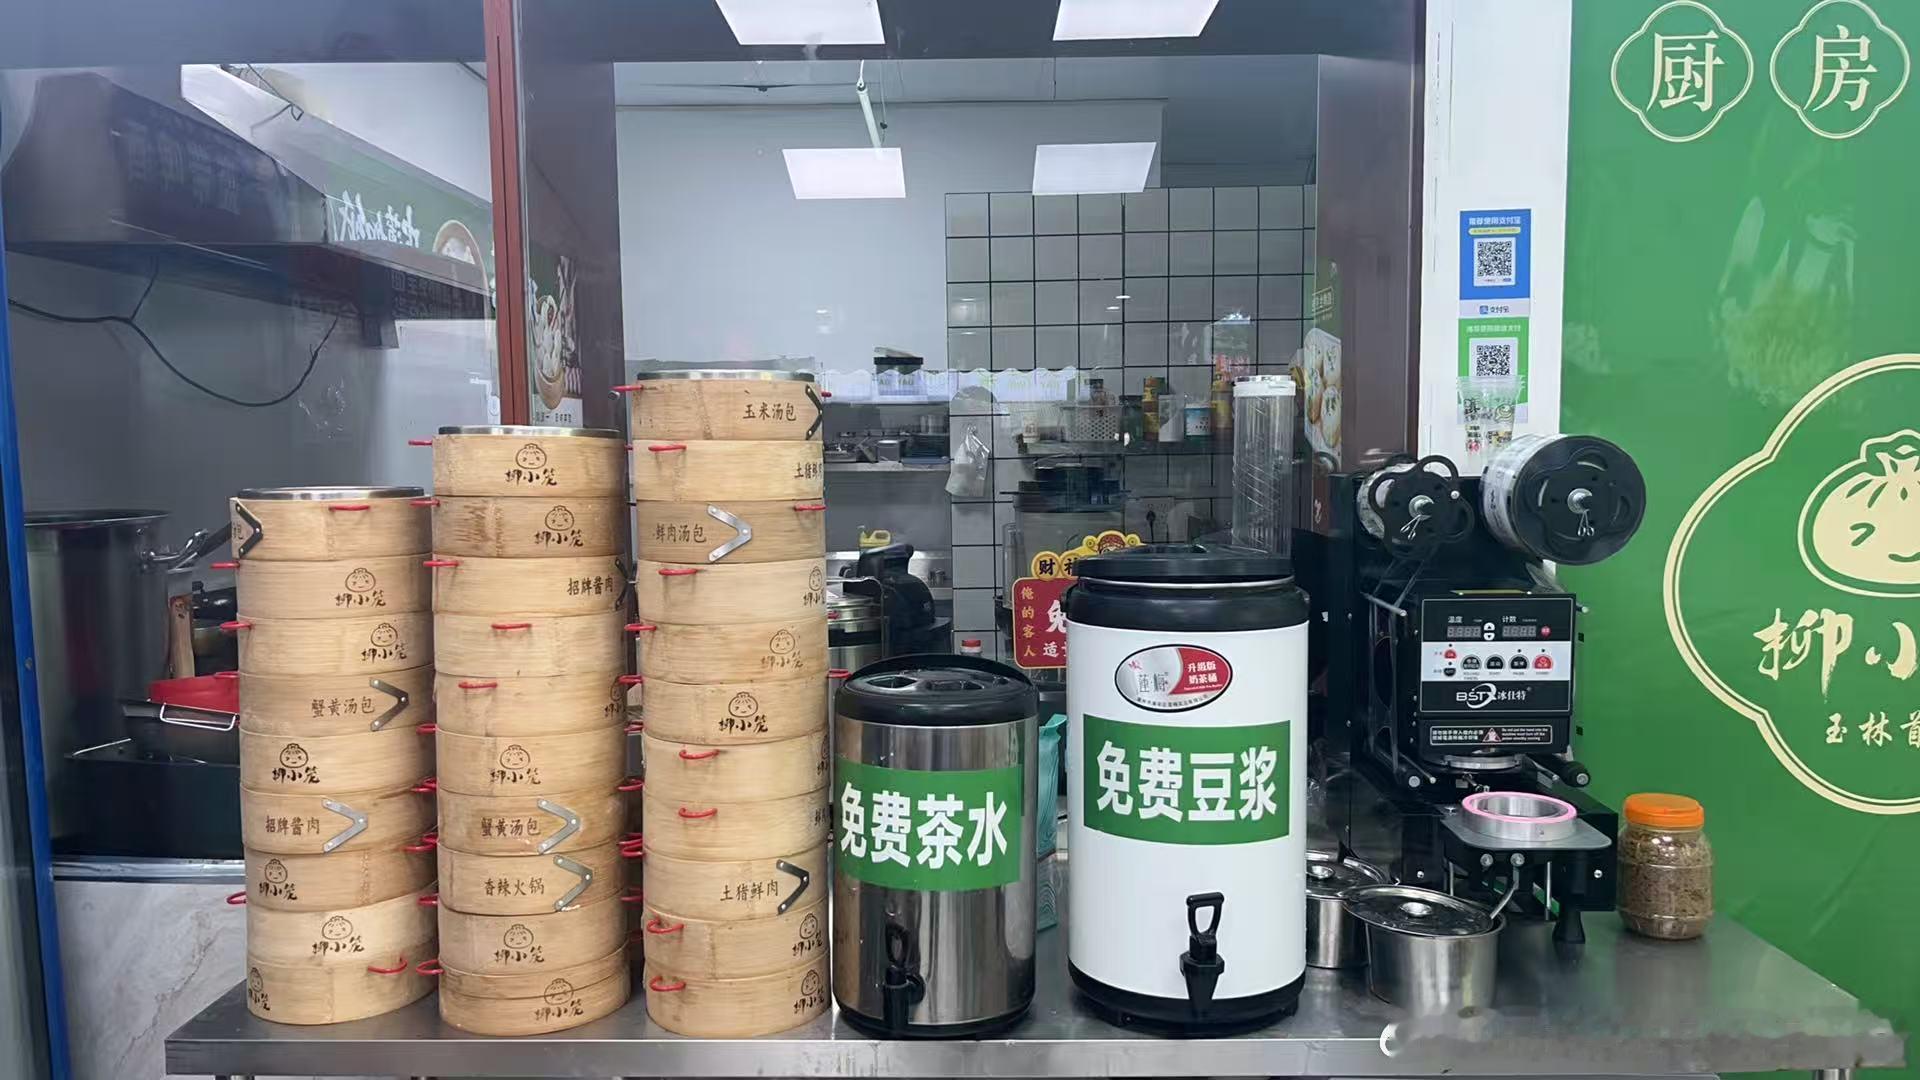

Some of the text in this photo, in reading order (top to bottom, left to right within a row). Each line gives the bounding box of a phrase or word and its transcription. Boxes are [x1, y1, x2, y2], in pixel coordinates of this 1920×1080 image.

[1646, 25, 1878, 111] 厨房
[742, 402, 797, 422] 玉米汤包
[654, 524, 707, 543] 鲜肉汤包
[568, 574, 614, 595] 招牌酱肉
[1021, 586, 1036, 657] 俺的客人
[1043, 641, 1067, 658] 适
[1188, 661, 1217, 673] 升级版
[311, 696, 376, 718] 蟹黄汤包
[1097, 740, 1277, 823] 免费豆浆
[265, 815, 320, 836] 招牌酱肉
[481, 817, 541, 837] 蟹黄汤包
[840, 782, 1008, 869] 免费茶水
[484, 877, 545, 897] 香辣火锅
[720, 879, 779, 902] 土猪鲜肉
